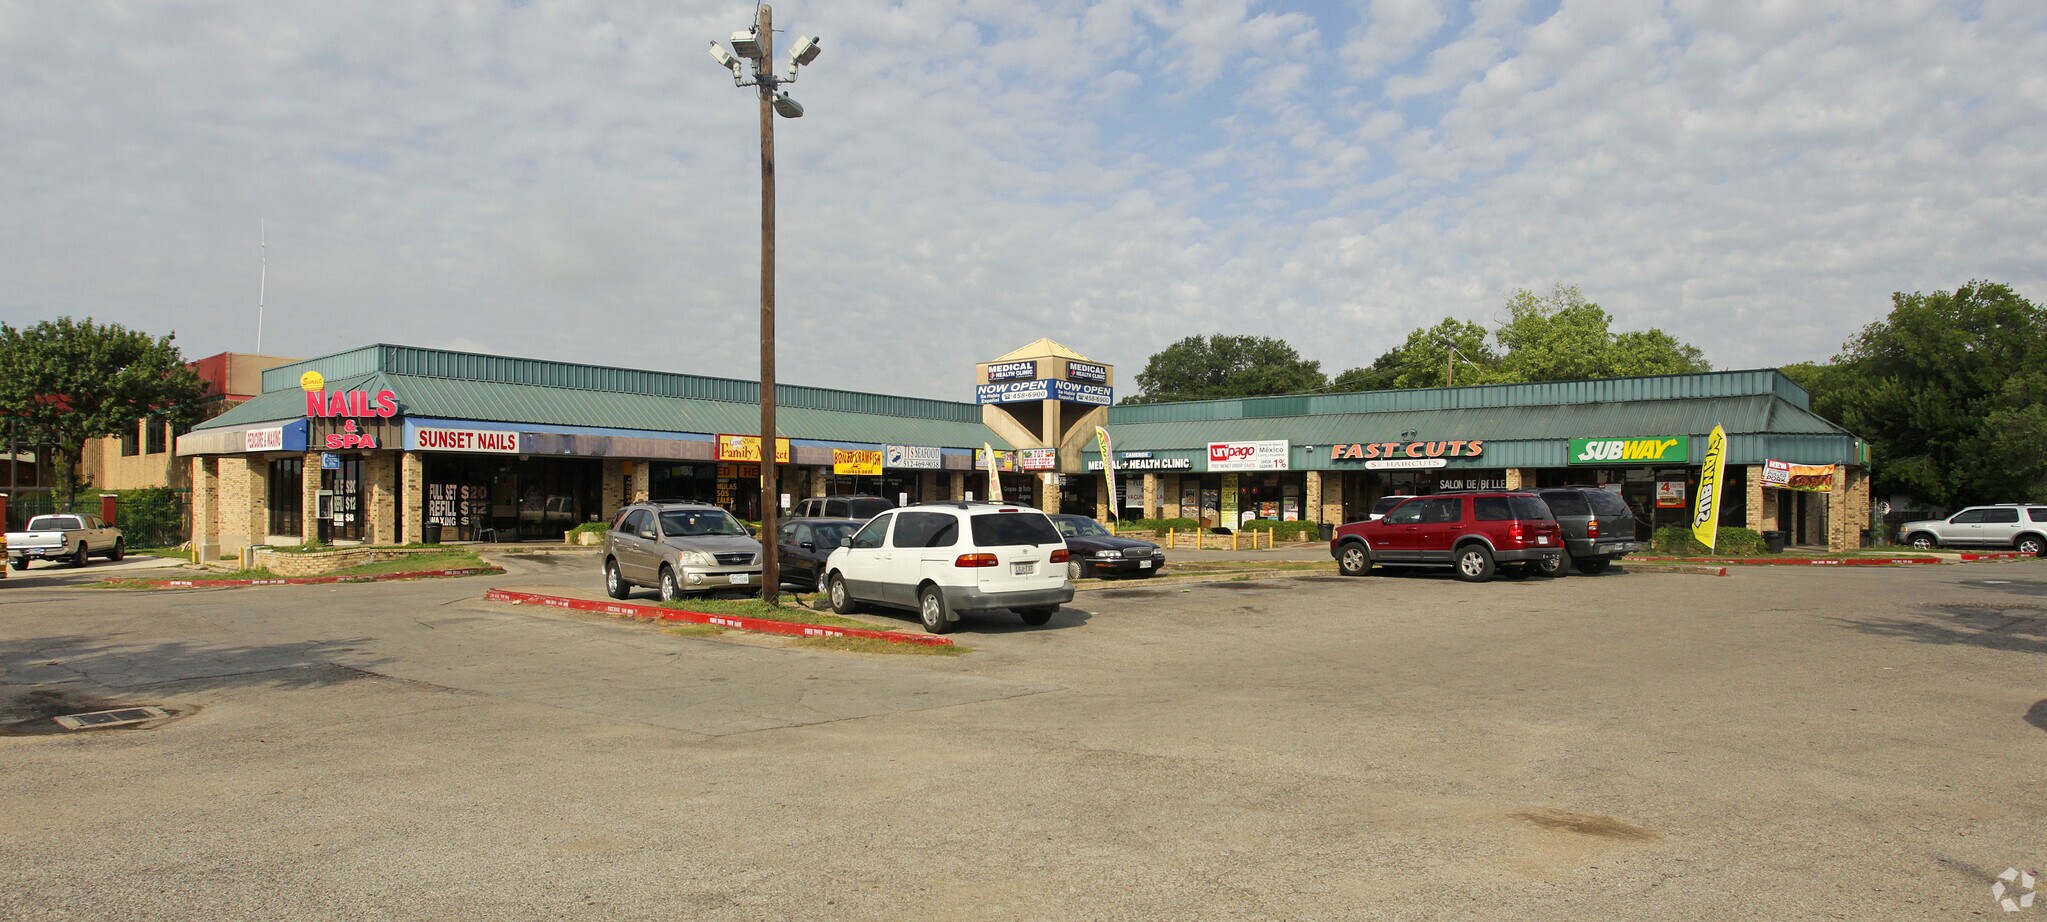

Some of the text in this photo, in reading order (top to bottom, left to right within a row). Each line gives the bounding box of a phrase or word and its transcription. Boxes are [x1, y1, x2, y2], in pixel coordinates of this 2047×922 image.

[988, 363, 1033, 373] MEDICAL
[1069, 363, 1105, 374] MEDICAL
[978, 380, 1047, 394] NOW OPEN
[1055, 380, 1111, 395] NOW OPEN
[306, 390, 397, 418] NAILS
[343, 419, 355, 433] &
[326, 434, 376, 449] SPA
[419, 430, 516, 451] SUNSET NAILS
[720, 442, 753, 460] Family
[1211, 445, 1255, 459] unipago
[1331, 440, 1484, 460] FAST CUTS
[1577, 438, 1678, 461] SUBWAY
[1088, 458, 1190, 470] MEDAL HEALTH CLINIC
[1273, 458, 1287, 469] 1%
[1386, 460, 1440, 468] HAIRCUTS
[1768, 460, 1787, 470] NEW
[429, 484, 443, 500] FULL
[445, 484, 457, 500] SET
[1439, 480, 1463, 490] SALON
[1467, 480, 1476, 489] DE
[345, 496, 356, 512] $12
[429, 500, 457, 517] REFILL
[345, 513, 355, 523] $8
[429, 517, 457, 526] WAXING
